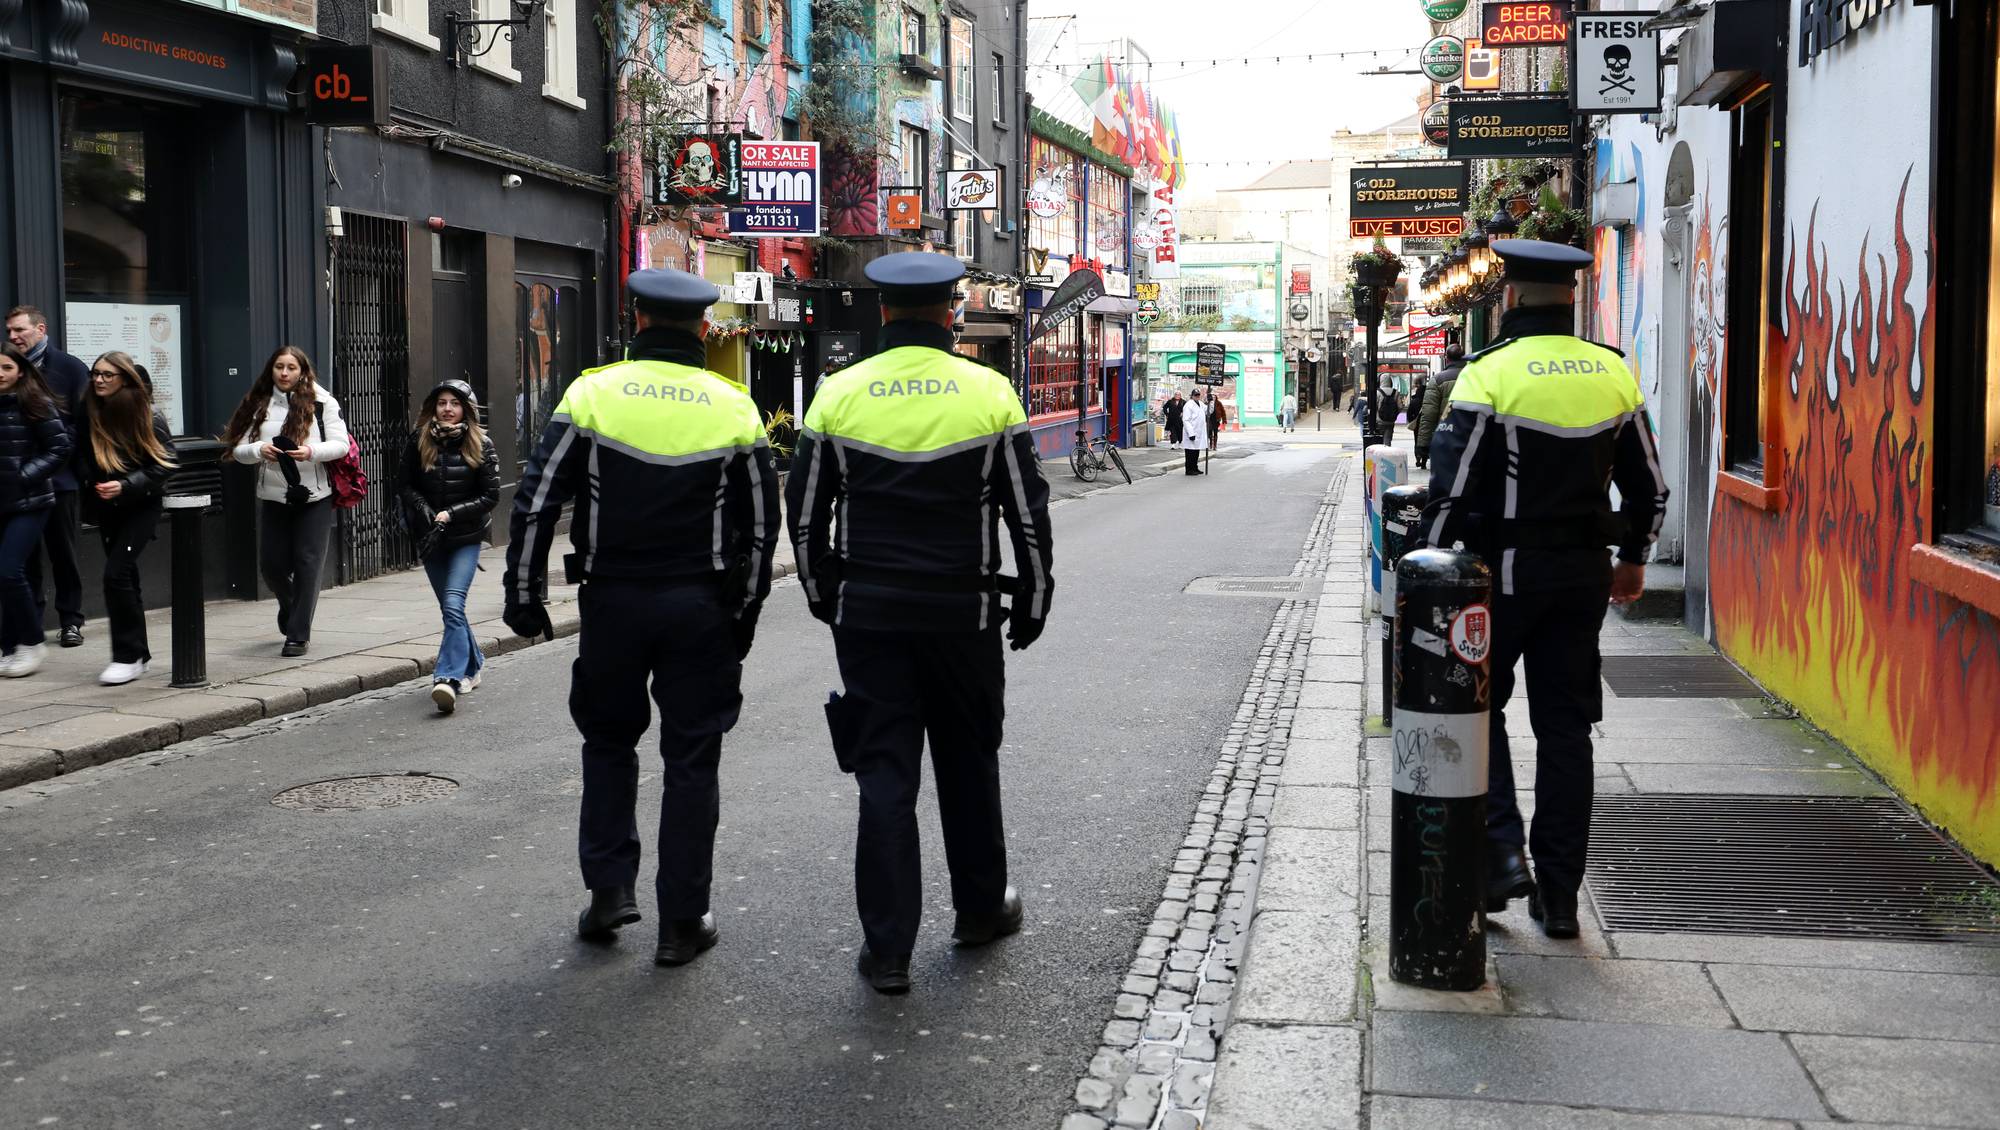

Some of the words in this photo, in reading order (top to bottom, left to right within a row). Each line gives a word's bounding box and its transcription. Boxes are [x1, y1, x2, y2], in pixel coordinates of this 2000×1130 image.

[1500, 5, 1551, 22] BEER
[1487, 24, 1566, 42] GARDEN
[102, 31, 168, 56] ADDICTIVE
[172, 46, 226, 69] GROOVES
[1456, 115, 1471, 126] The
[1472, 115, 1501, 126] OLD
[1458, 125, 1568, 138] STOREHOUSE
[1527, 139, 1536, 147] Bar
[772, 147, 809, 160] SALE
[728, 139, 739, 195] city
[1353, 177, 1367, 189] The
[1369, 178, 1396, 188] OLD
[1357, 188, 1458, 201] STOREHOUSE
[756, 206, 791, 214] fanda.ie
[1027, 201, 1047, 210] BAD
[1048, 201, 1067, 210] ASS
[746, 215, 799, 226] 8211311
[1355, 222, 1393, 235] LIVE
[1401, 221, 1459, 234] MUSIC
[1191, 251, 1213, 261] THE
[1217, 251, 1240, 261] OLD
[1243, 250, 1271, 260] MILL
[1136, 283, 1160, 292] BAD
[1138, 292, 1159, 300] ASS
[1042, 287, 1099, 331] PIERCING
[1163, 339, 1186, 349] OLD
[1527, 359, 1609, 376] GARDA
[622, 382, 712, 406] GARDA
[868, 379, 961, 397] GARDA
